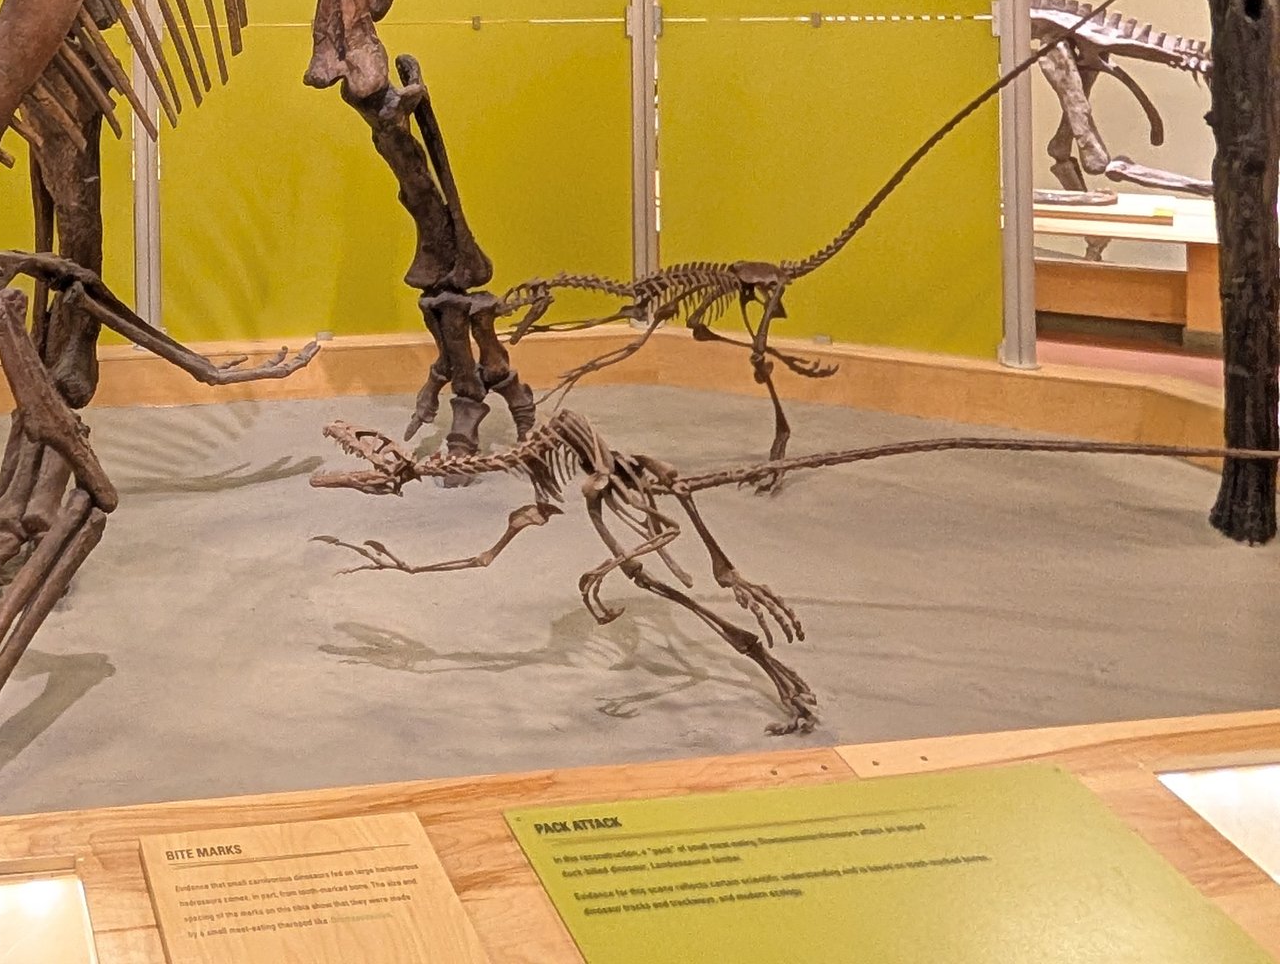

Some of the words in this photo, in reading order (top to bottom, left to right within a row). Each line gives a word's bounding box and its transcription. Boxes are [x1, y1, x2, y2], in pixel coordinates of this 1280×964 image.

[534, 821, 571, 834] PACK
[572, 817, 622, 831] ATTACK
[166, 849, 194, 860] BITE
[196, 844, 242, 858] MARKS
[175, 884, 209, 893] Evidence
[227, 879, 247, 888] small
[248, 876, 292, 886] carnivorous
[370, 880, 386, 888] The
[574, 891, 615, 901] Evidence
[184, 914, 215, 924] spacing
[240, 908, 264, 916] marks
